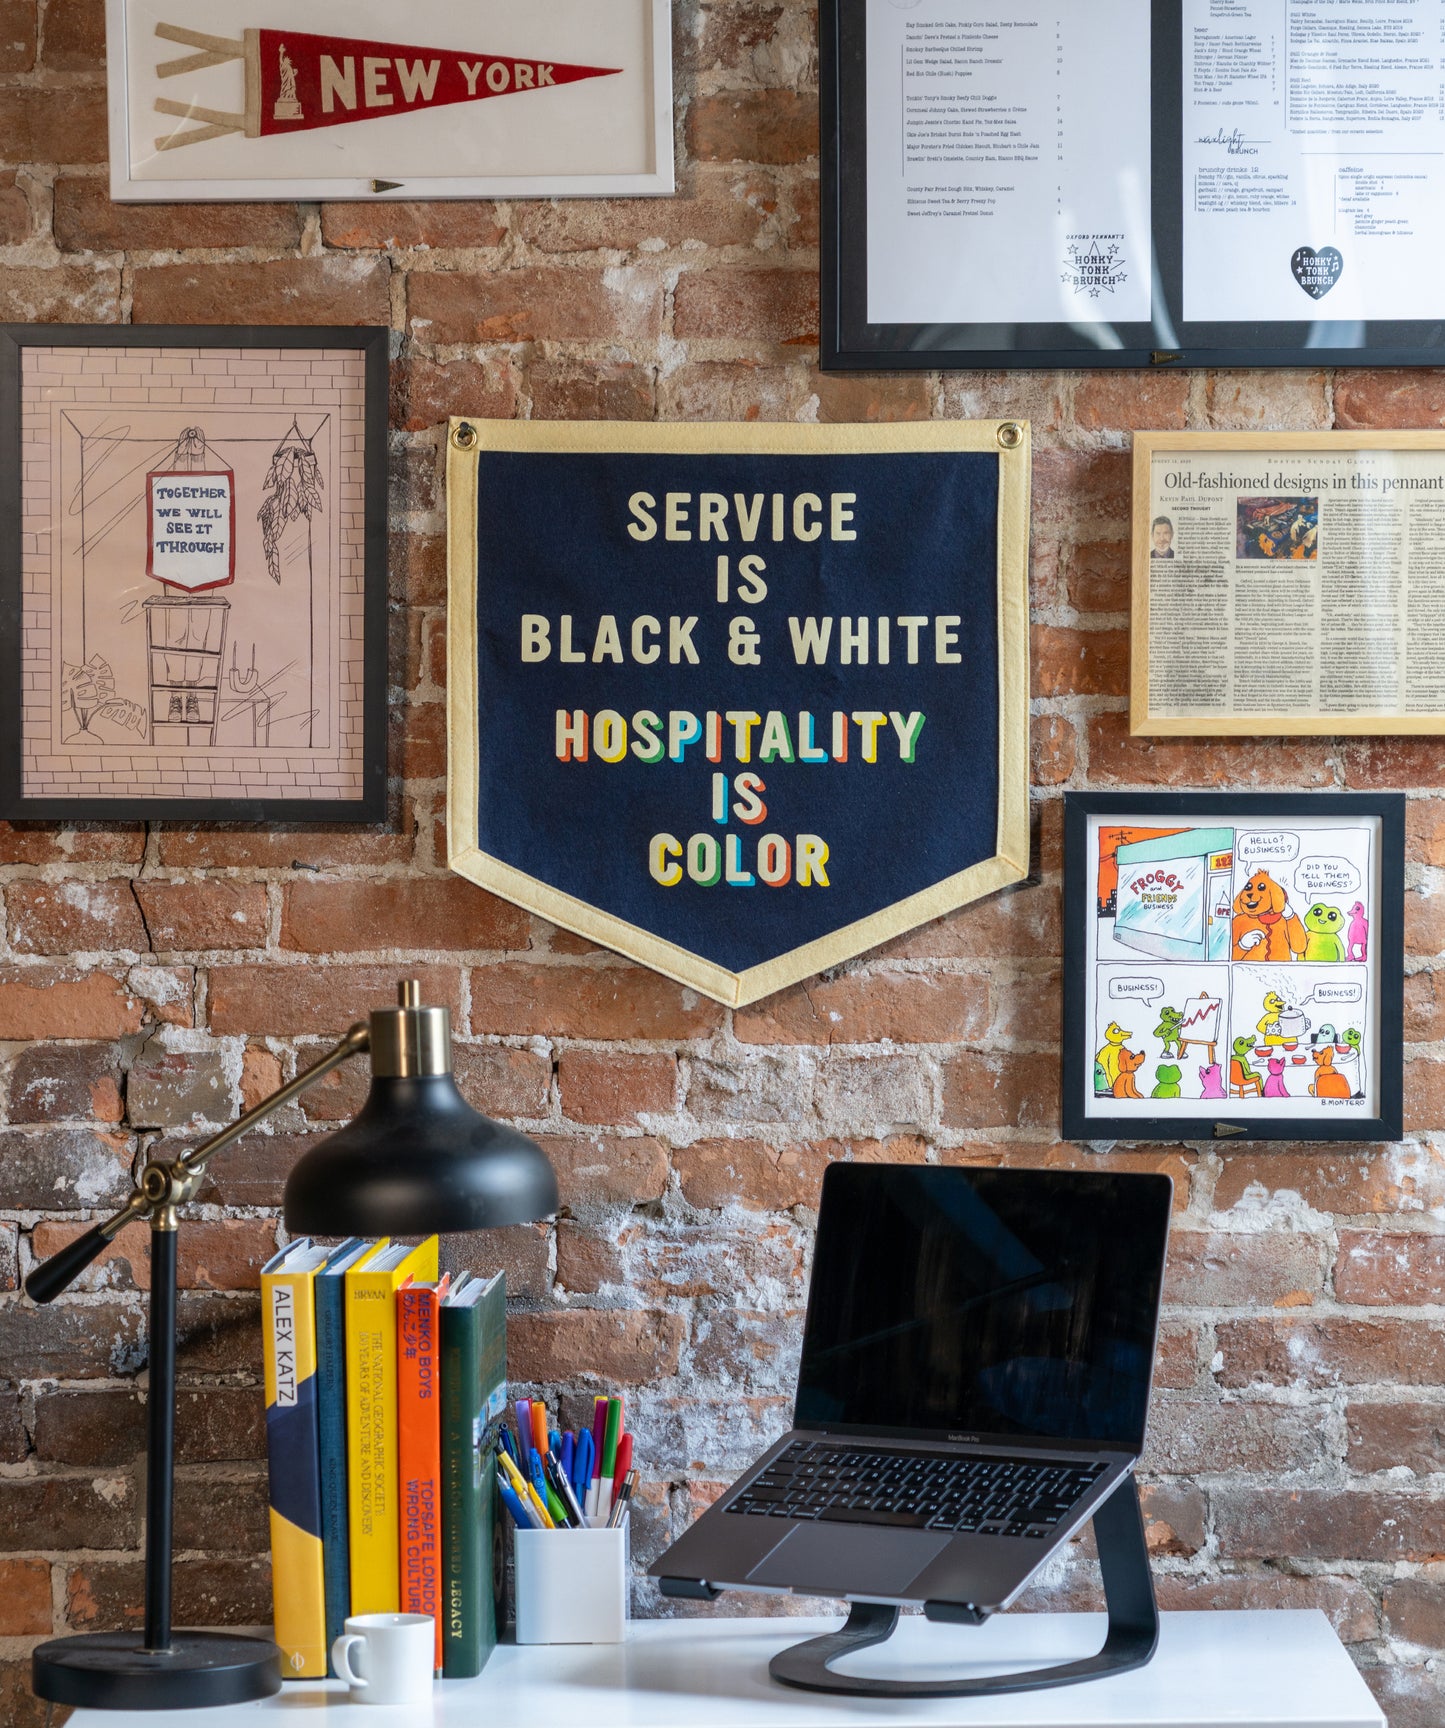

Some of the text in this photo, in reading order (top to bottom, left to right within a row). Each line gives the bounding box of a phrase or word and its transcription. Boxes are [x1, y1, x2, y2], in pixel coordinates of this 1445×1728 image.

[320, 54, 556, 113] NEW YORK
[1075, 256, 1113, 264] HONKY
[1303, 257, 1332, 266] HONKY
[1079, 266, 1109, 274] TONK
[1306, 267, 1329, 275] TONK
[1073, 276, 1116, 285] BRUNCH
[1301, 276, 1333, 285] BRUNCH
[1164, 472, 1444, 493] Old-fashioned designs in this pennant
[156, 486, 227, 499] TOGETHER
[156, 508, 222, 518] WE WILL
[627, 492, 858, 542] SERVICE
[166, 522, 212, 534] SEE IT
[156, 541, 224, 553] THROUGH
[716, 554, 769, 604] IS
[521, 614, 962, 665] BLACK & WHITE
[555, 709, 926, 763] HOSPITALITY
[712, 772, 767, 825] IS
[1250, 835, 1284, 844] HELLO?
[1244, 845, 1292, 855] BUSINESS?
[648, 832, 830, 886] COLOR
[1130, 870, 1184, 895] FROGGY
[1307, 880, 1353, 889] BUSINESS?
[1142, 893, 1177, 903] FRIENDS
[1117, 983, 1158, 992] BUSINESS!
[1318, 988, 1356, 997] BUSINESS!
[354, 1290, 386, 1300] BRYAN
[274, 1289, 294, 1401] ALEX KATZ
[418, 1294, 432, 1398] MENKO BOYS
[360, 1345, 369, 1379] YEARS
[360, 1382, 369, 1394] OF
[361, 1396, 370, 1455] ADVENTURE
[372, 1332, 385, 1516] THE NATIONAL GEOGRAPHIC SOCIETY
[361, 1459, 371, 1480] AND
[406, 1479, 419, 1541] WRONG
[421, 1480, 435, 1617] TOPSAFE LONDO
[451, 1580, 462, 1638] LEGACY
